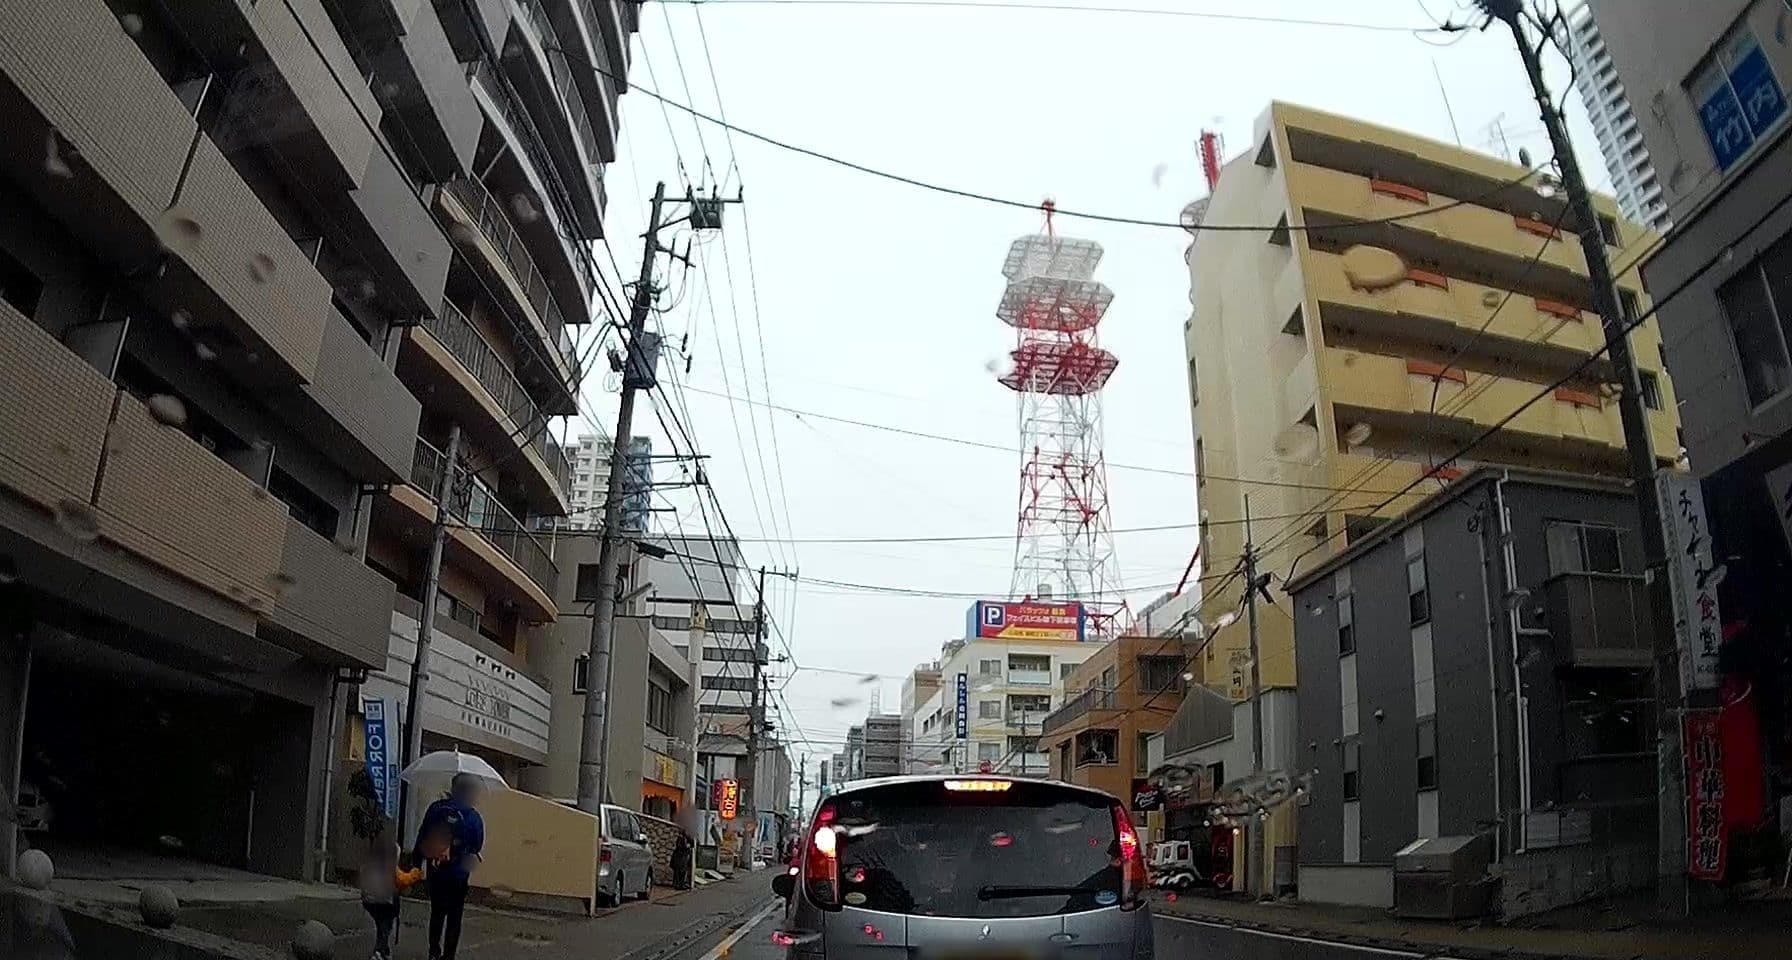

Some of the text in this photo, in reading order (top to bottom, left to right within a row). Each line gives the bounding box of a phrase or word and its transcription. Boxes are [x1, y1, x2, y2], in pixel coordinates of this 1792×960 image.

[987, 607, 1000, 624] P
[1695, 735, 1722, 873] 中華料理
